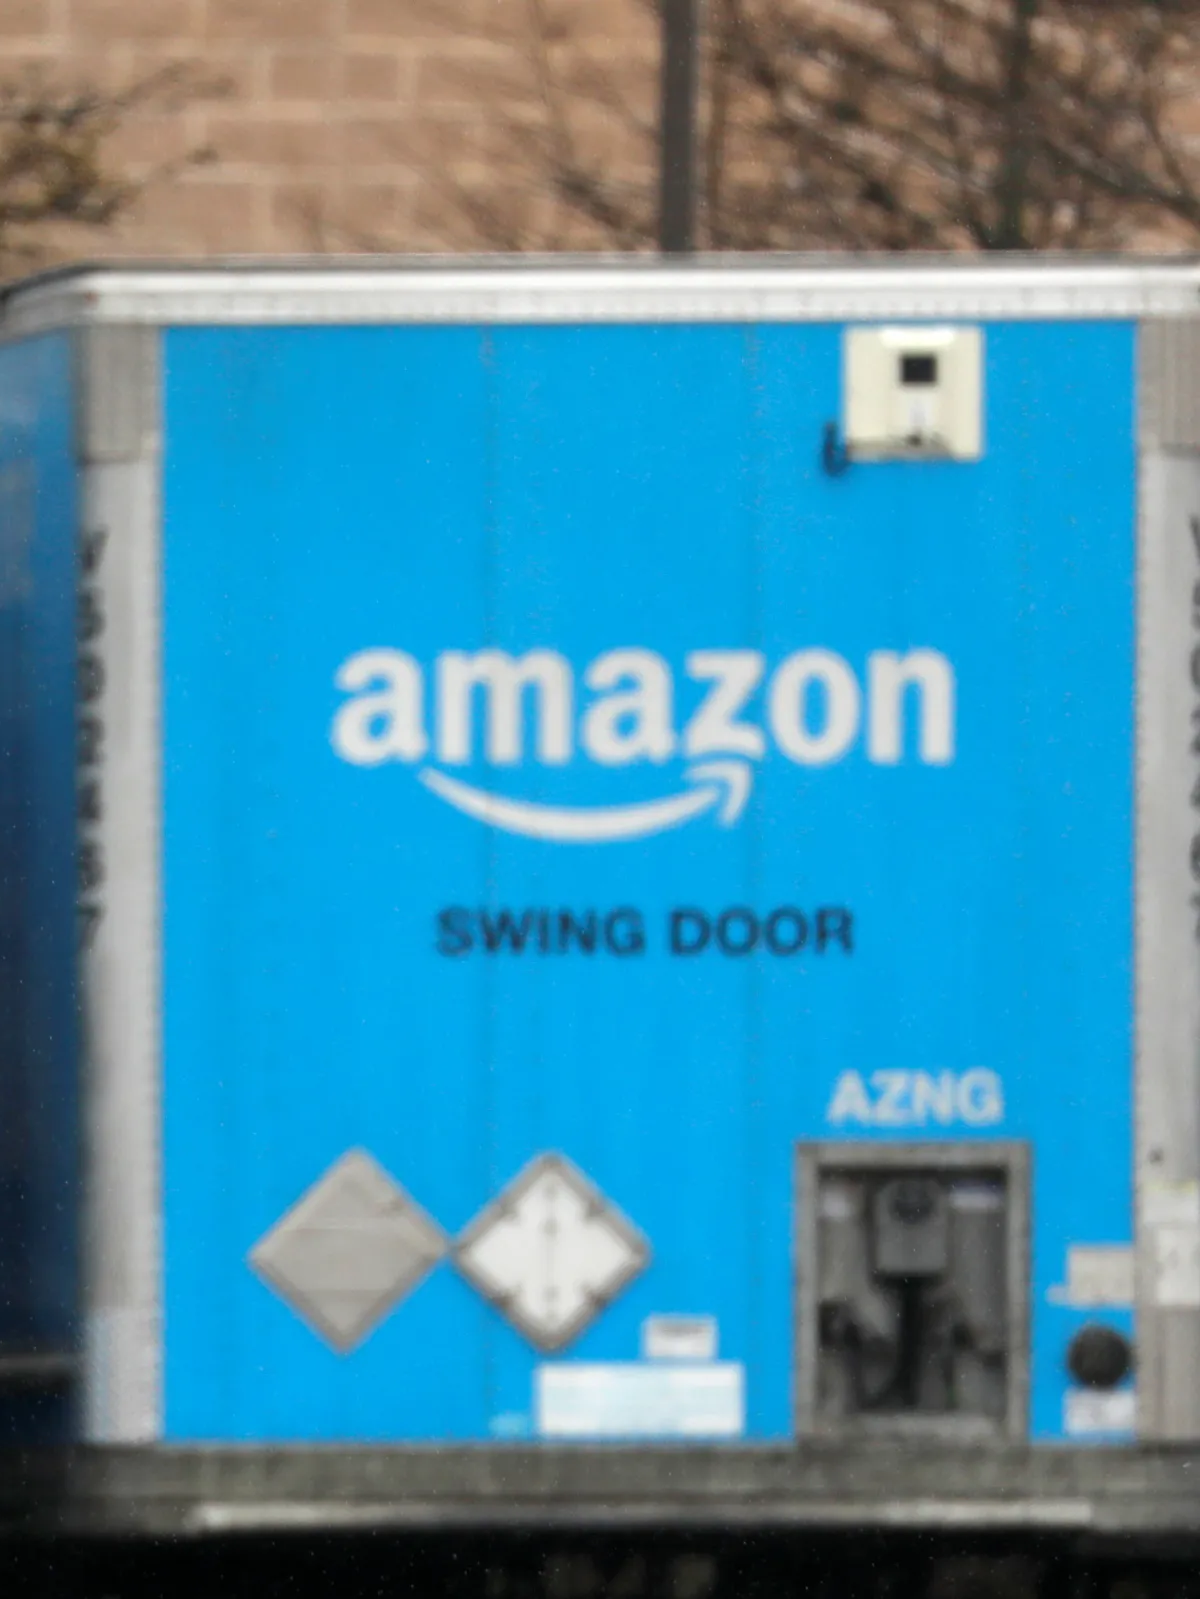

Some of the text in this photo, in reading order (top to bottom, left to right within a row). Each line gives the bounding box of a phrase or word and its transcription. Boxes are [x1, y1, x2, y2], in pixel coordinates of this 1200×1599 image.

[332, 648, 955, 766] amazon
[437, 905, 854, 957] SWING DOOR
[828, 1069, 1004, 1125] AZNG
